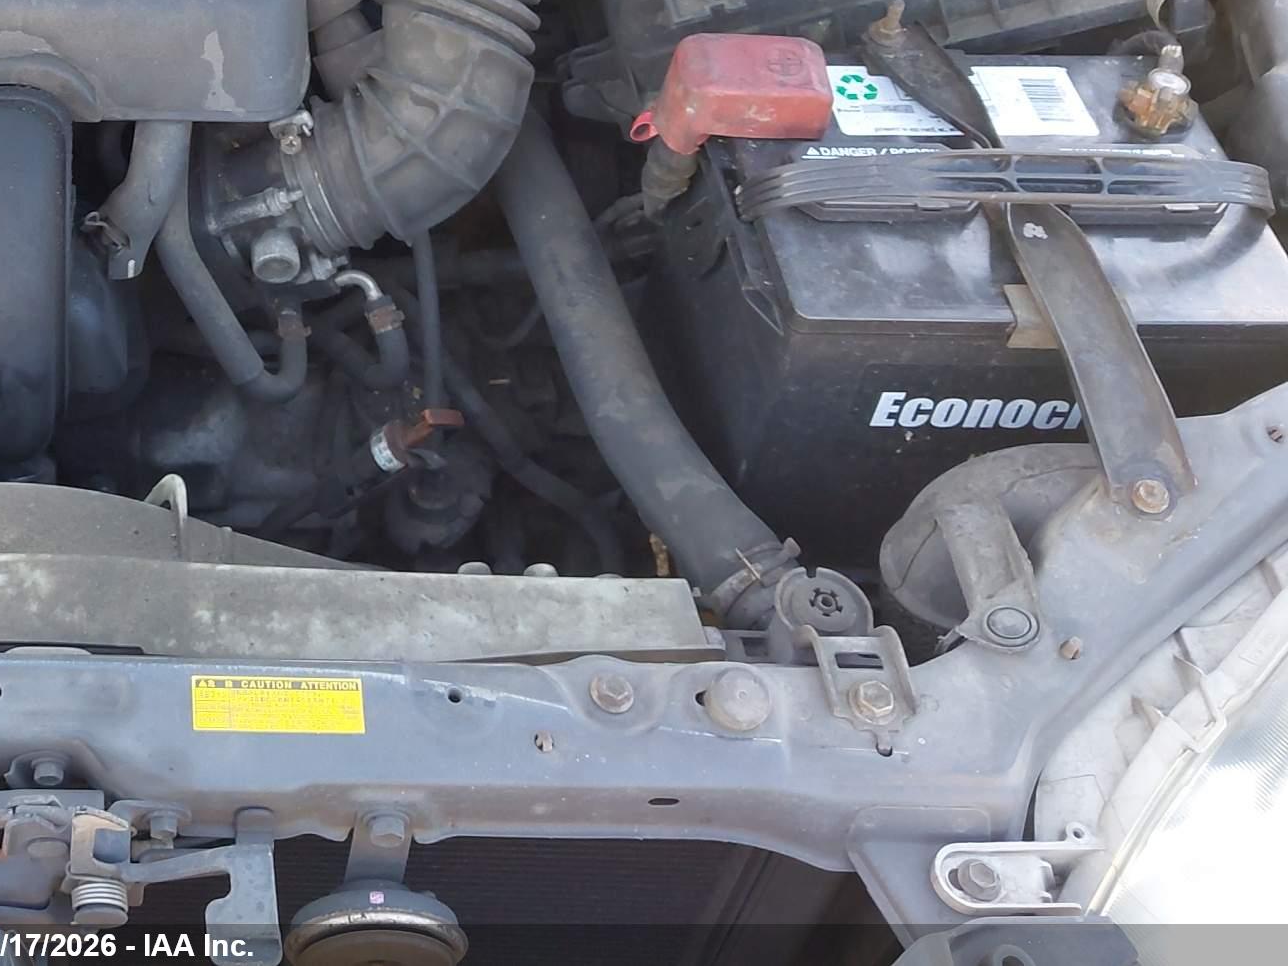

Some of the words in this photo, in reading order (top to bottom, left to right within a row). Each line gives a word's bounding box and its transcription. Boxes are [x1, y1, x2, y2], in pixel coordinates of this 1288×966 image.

[819, 146, 878, 157] DANGER
[241, 680, 292, 690] CAUTION
[301, 680, 358, 690] ATTENTION
